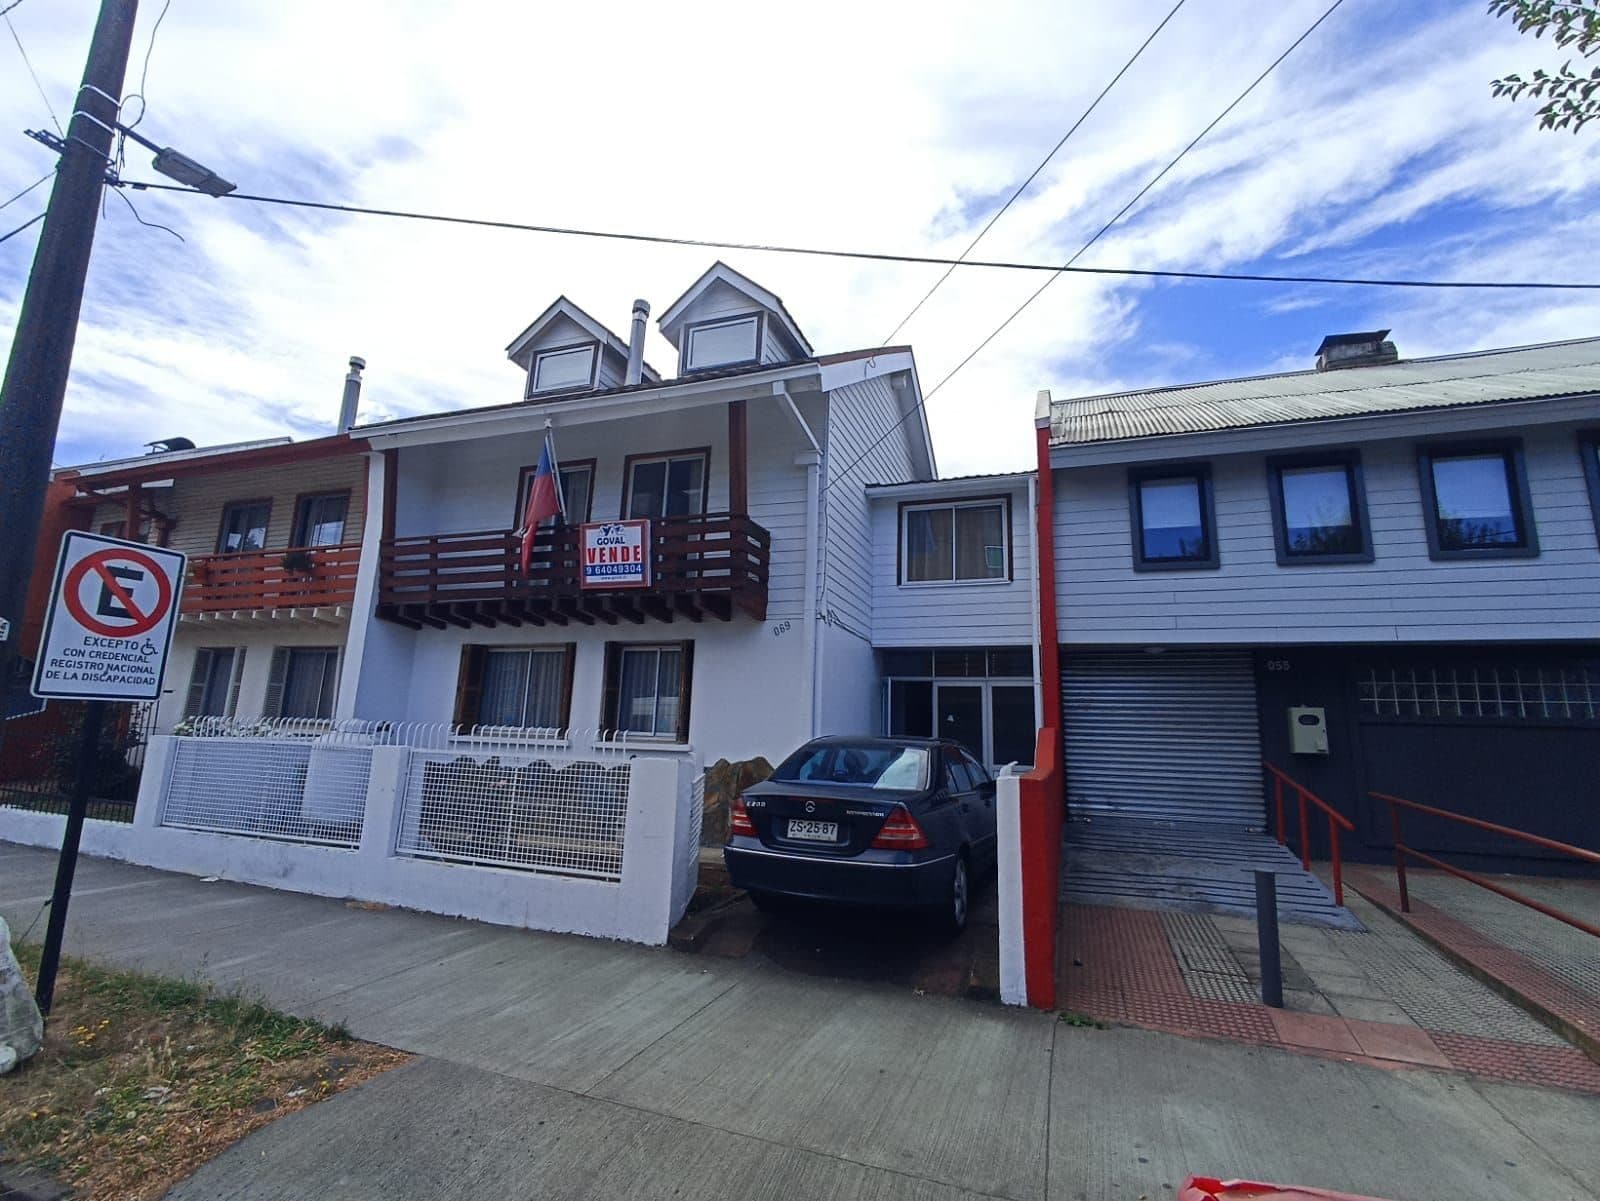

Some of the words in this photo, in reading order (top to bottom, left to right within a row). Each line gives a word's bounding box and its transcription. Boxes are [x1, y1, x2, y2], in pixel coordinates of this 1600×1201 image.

[597, 536, 626, 545] GOVAL
[587, 545, 641, 564] VENDE
[586, 566, 592, 575] 9
[83, 636, 139, 650] EXCEPTO
[63, 648, 86, 658] CON
[88, 649, 150, 664] CREDENCIAL
[50, 658, 104, 671] REGISTRO
[106, 663, 155, 675] NACIONAL
[45, 670, 60, 680] DE
[63, 671, 79, 681] LA
[81, 672, 156, 686] DISCAPACIDAD
